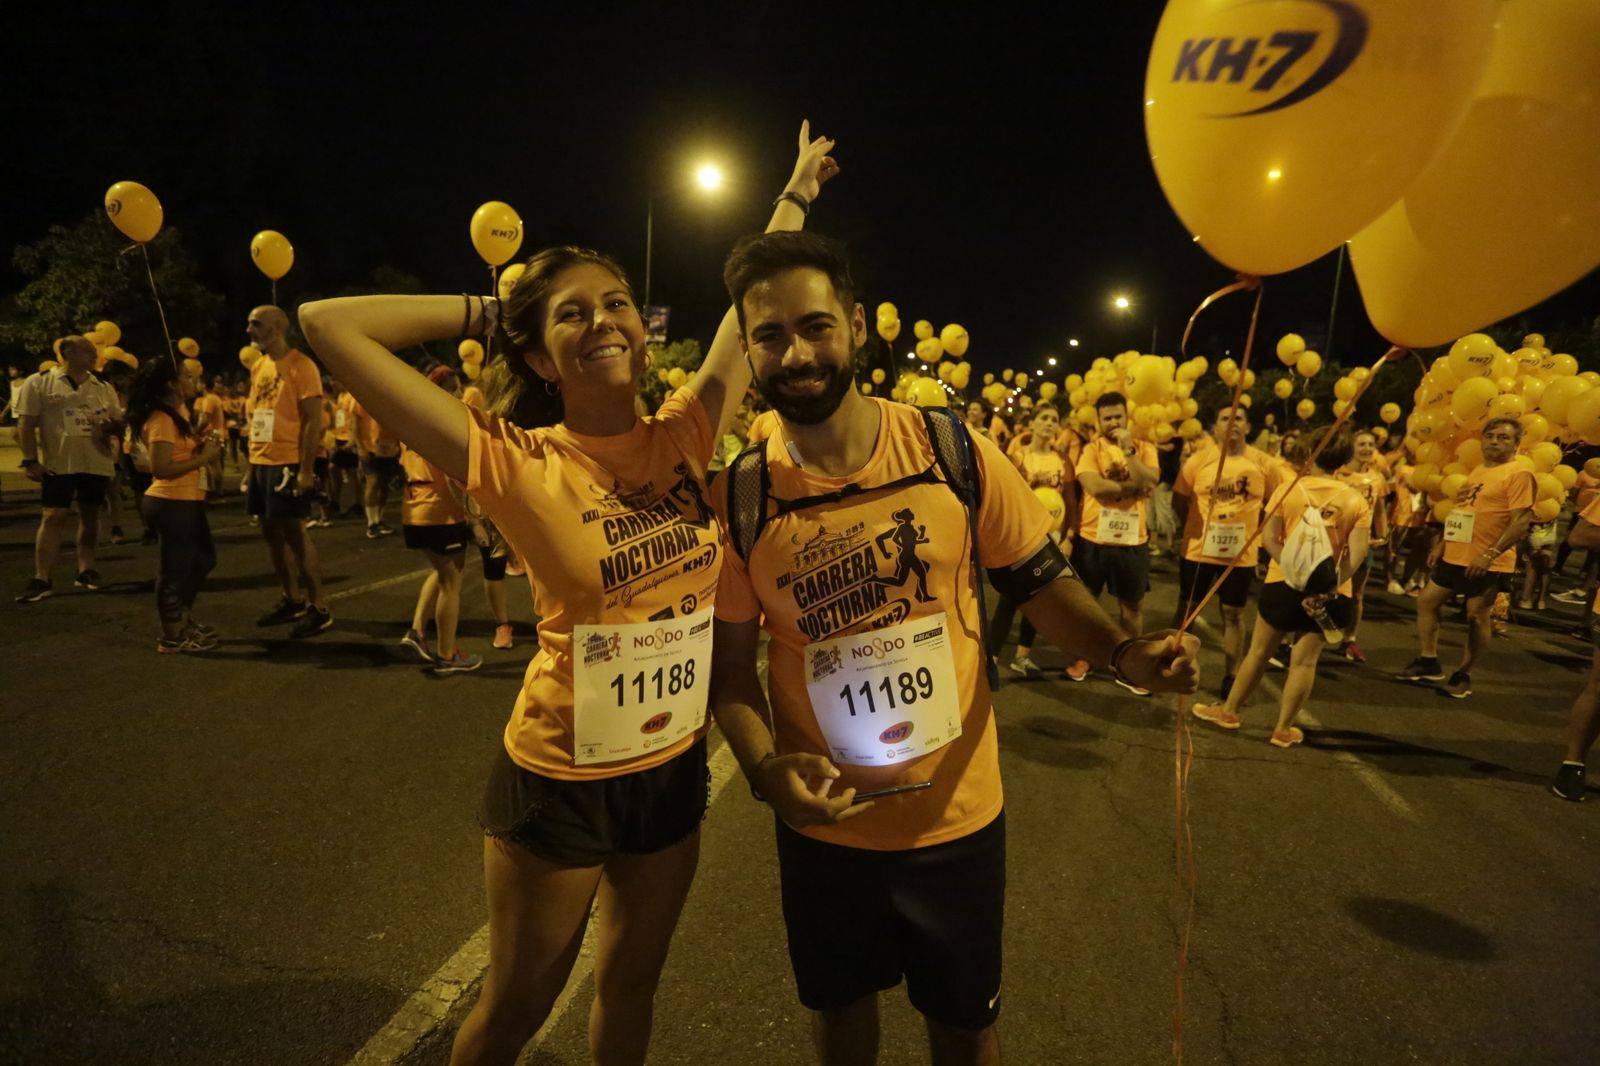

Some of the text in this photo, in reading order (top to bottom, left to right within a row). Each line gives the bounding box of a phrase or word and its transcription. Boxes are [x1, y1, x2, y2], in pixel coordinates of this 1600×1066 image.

[602, 497, 684, 546] CARRERA
[1211, 535, 1239, 546] 13275
[600, 525, 700, 589] NOCTURNA
[792, 545, 878, 609] CARRERA
[797, 583, 888, 640] NOCTURNA
[610, 658, 695, 707] 11188
[839, 666, 934, 717] 11189
